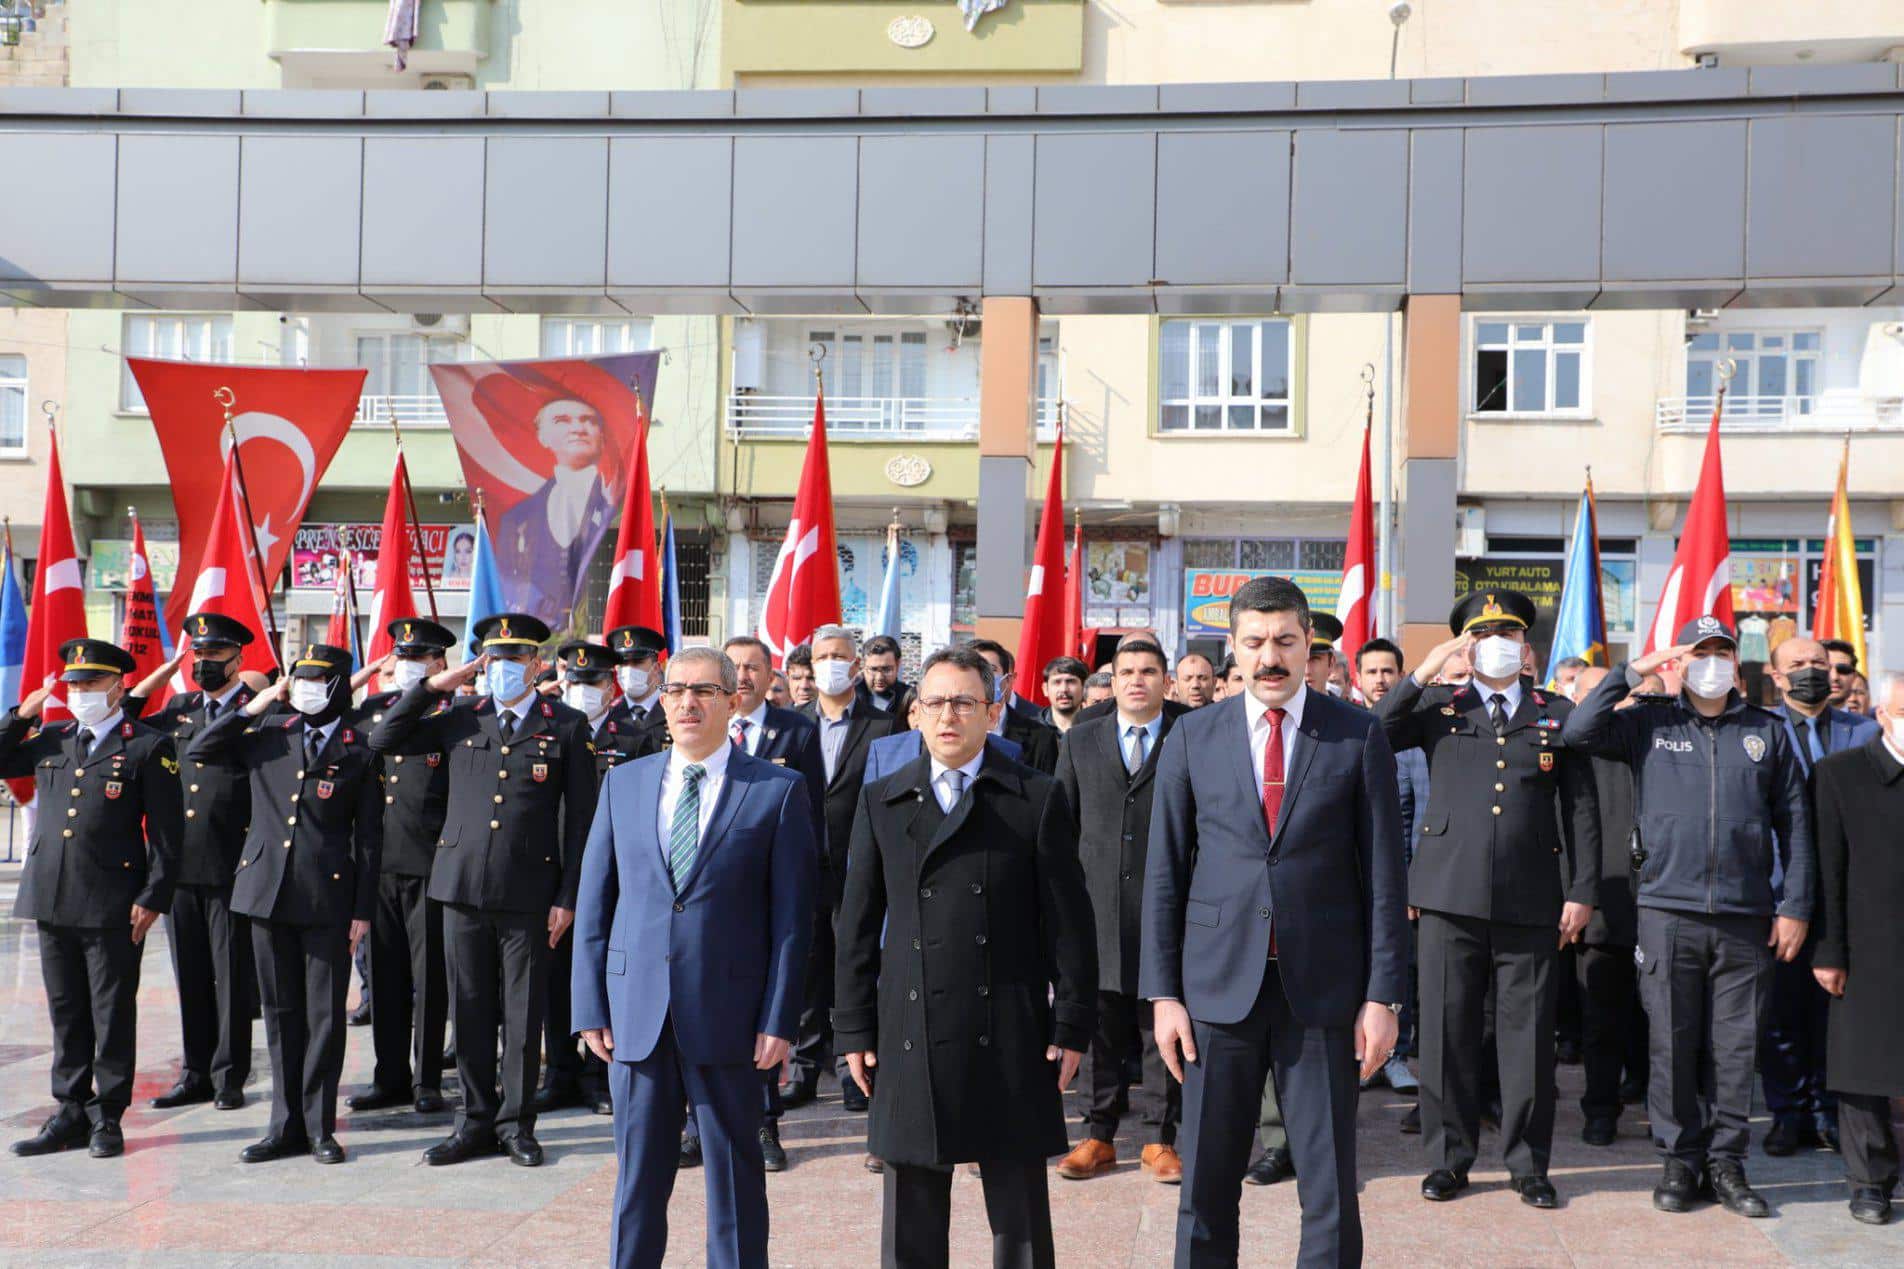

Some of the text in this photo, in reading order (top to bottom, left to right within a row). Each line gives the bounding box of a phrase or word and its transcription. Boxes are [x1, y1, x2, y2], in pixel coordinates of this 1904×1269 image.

[295, 528, 384, 553] PRENSESLE
[1486, 566, 1552, 578] YURT AUTO
